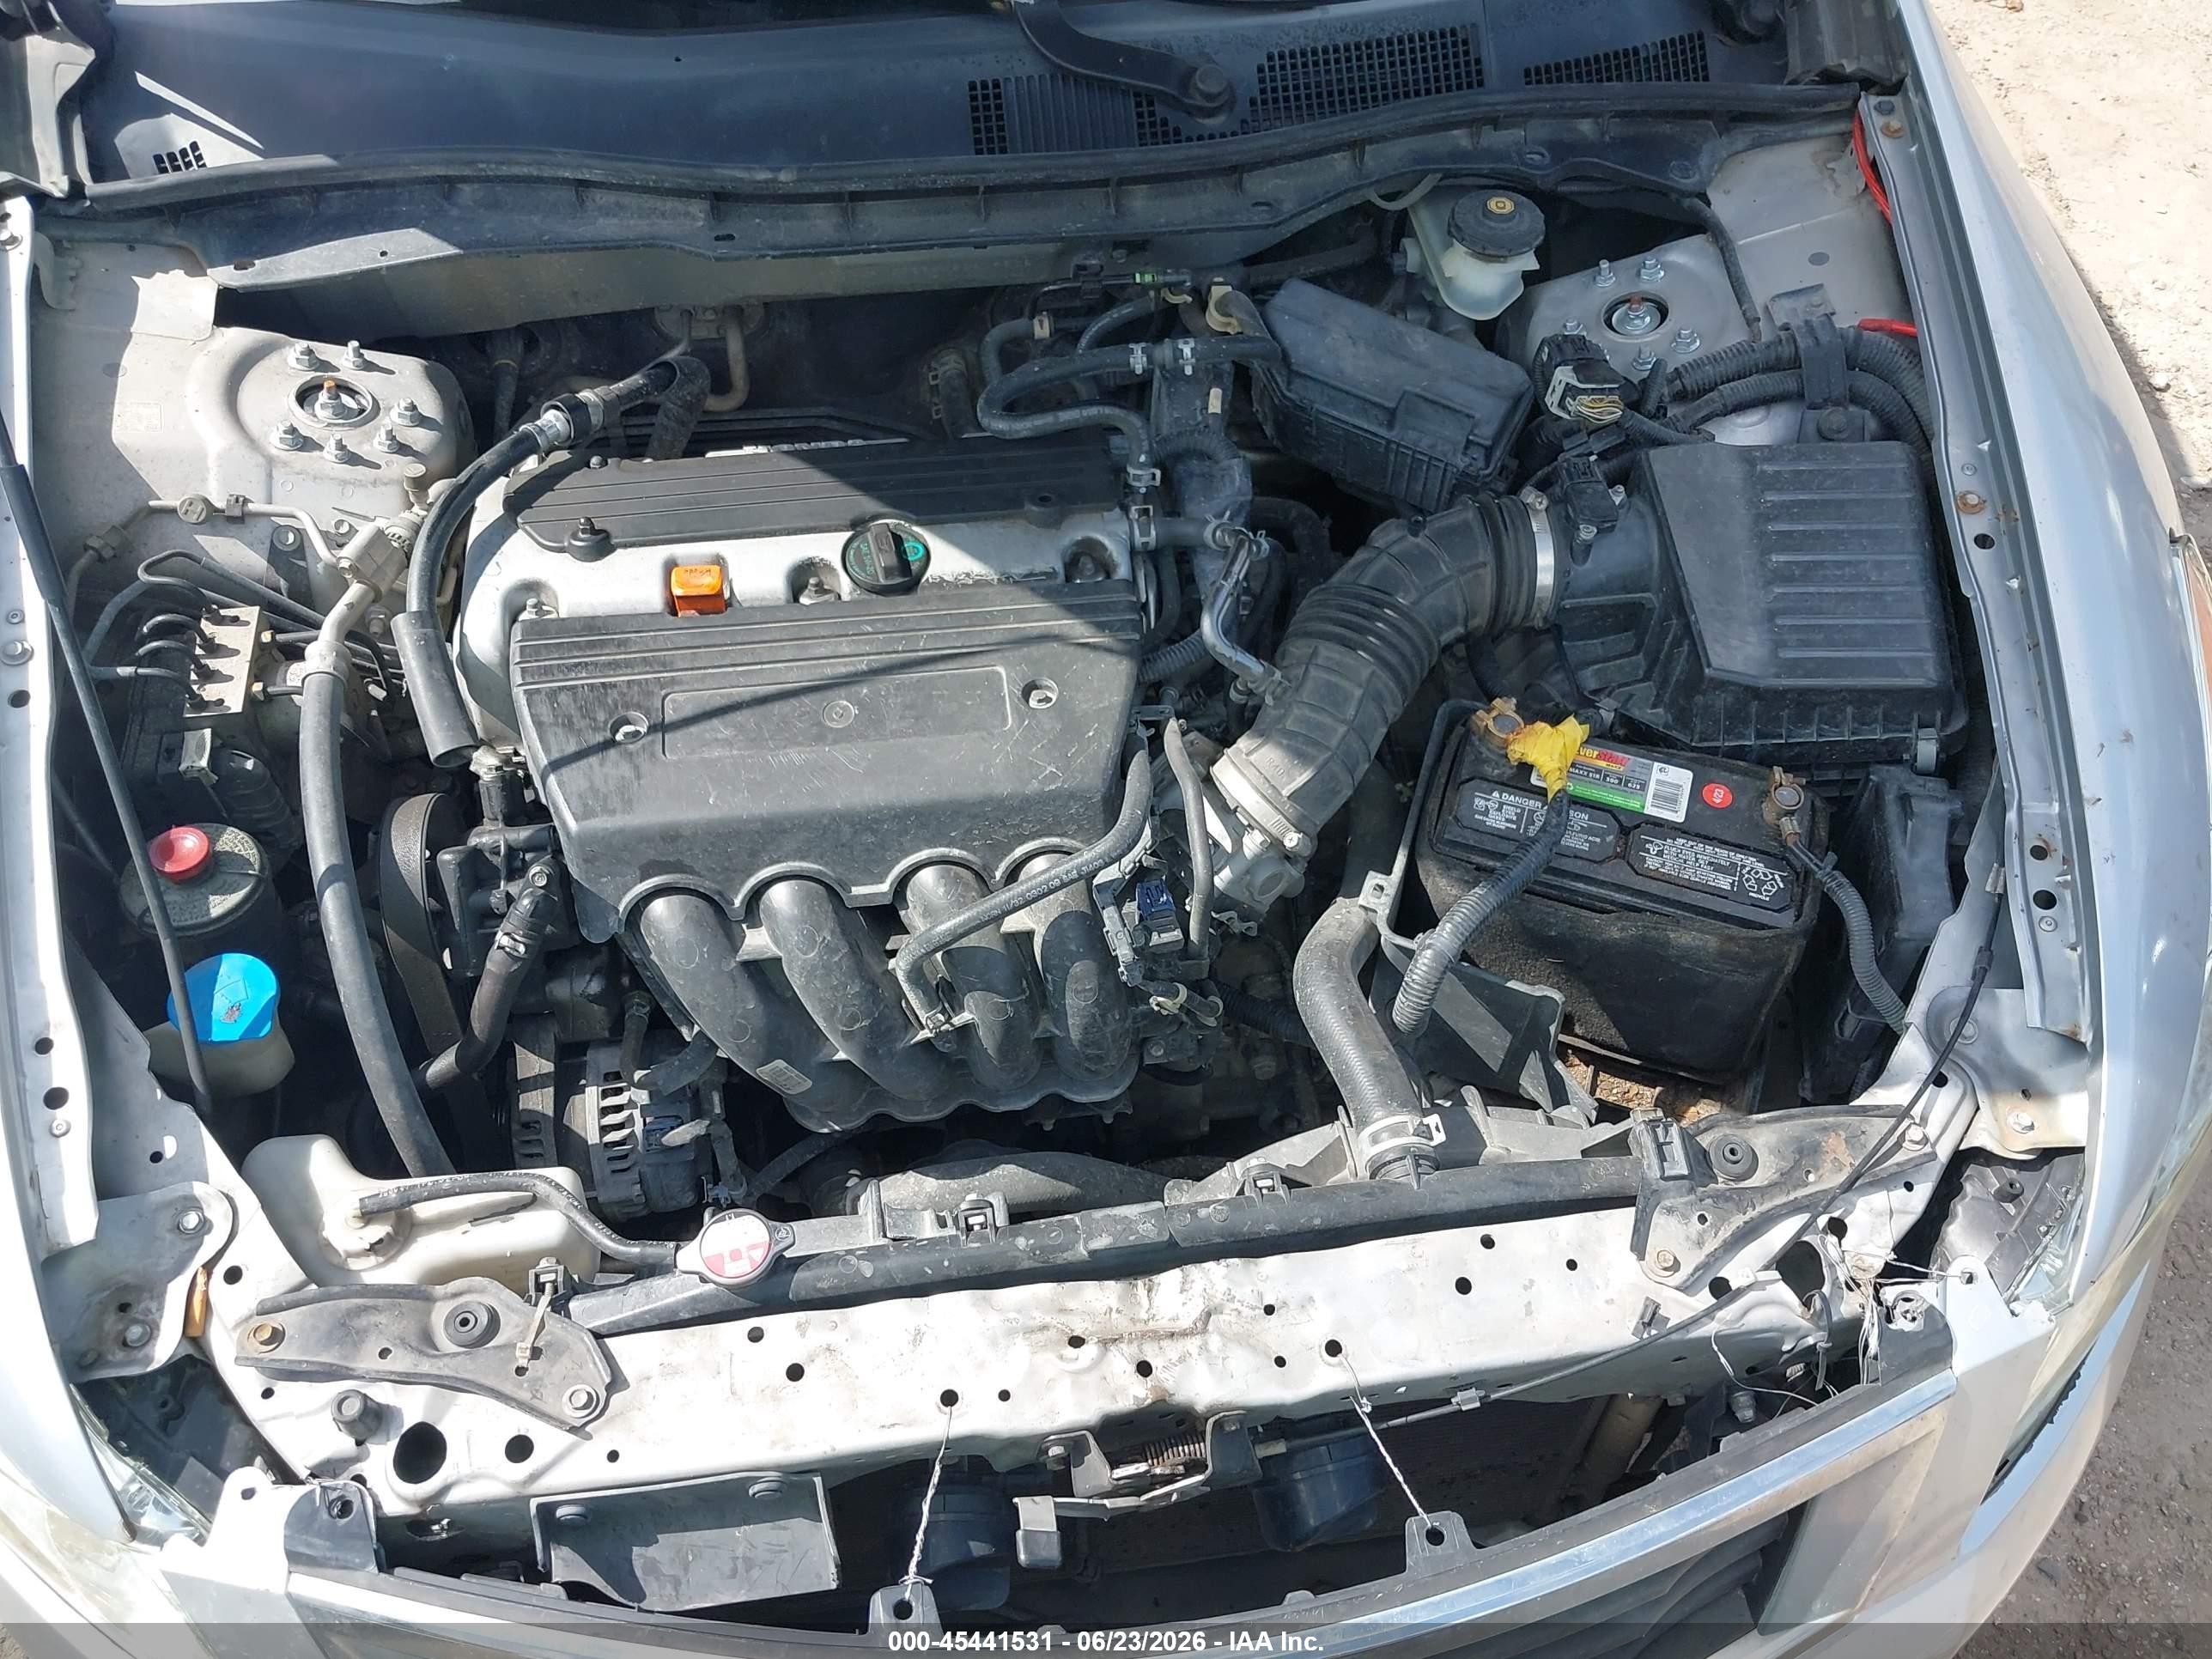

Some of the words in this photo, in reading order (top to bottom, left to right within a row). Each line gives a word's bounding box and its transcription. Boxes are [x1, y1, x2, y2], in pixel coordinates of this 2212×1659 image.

[1577, 746, 1630, 766] verStart
[1502, 793, 1542, 808] DANGER
[1697, 854, 1729, 866] IMMEDIATELY
